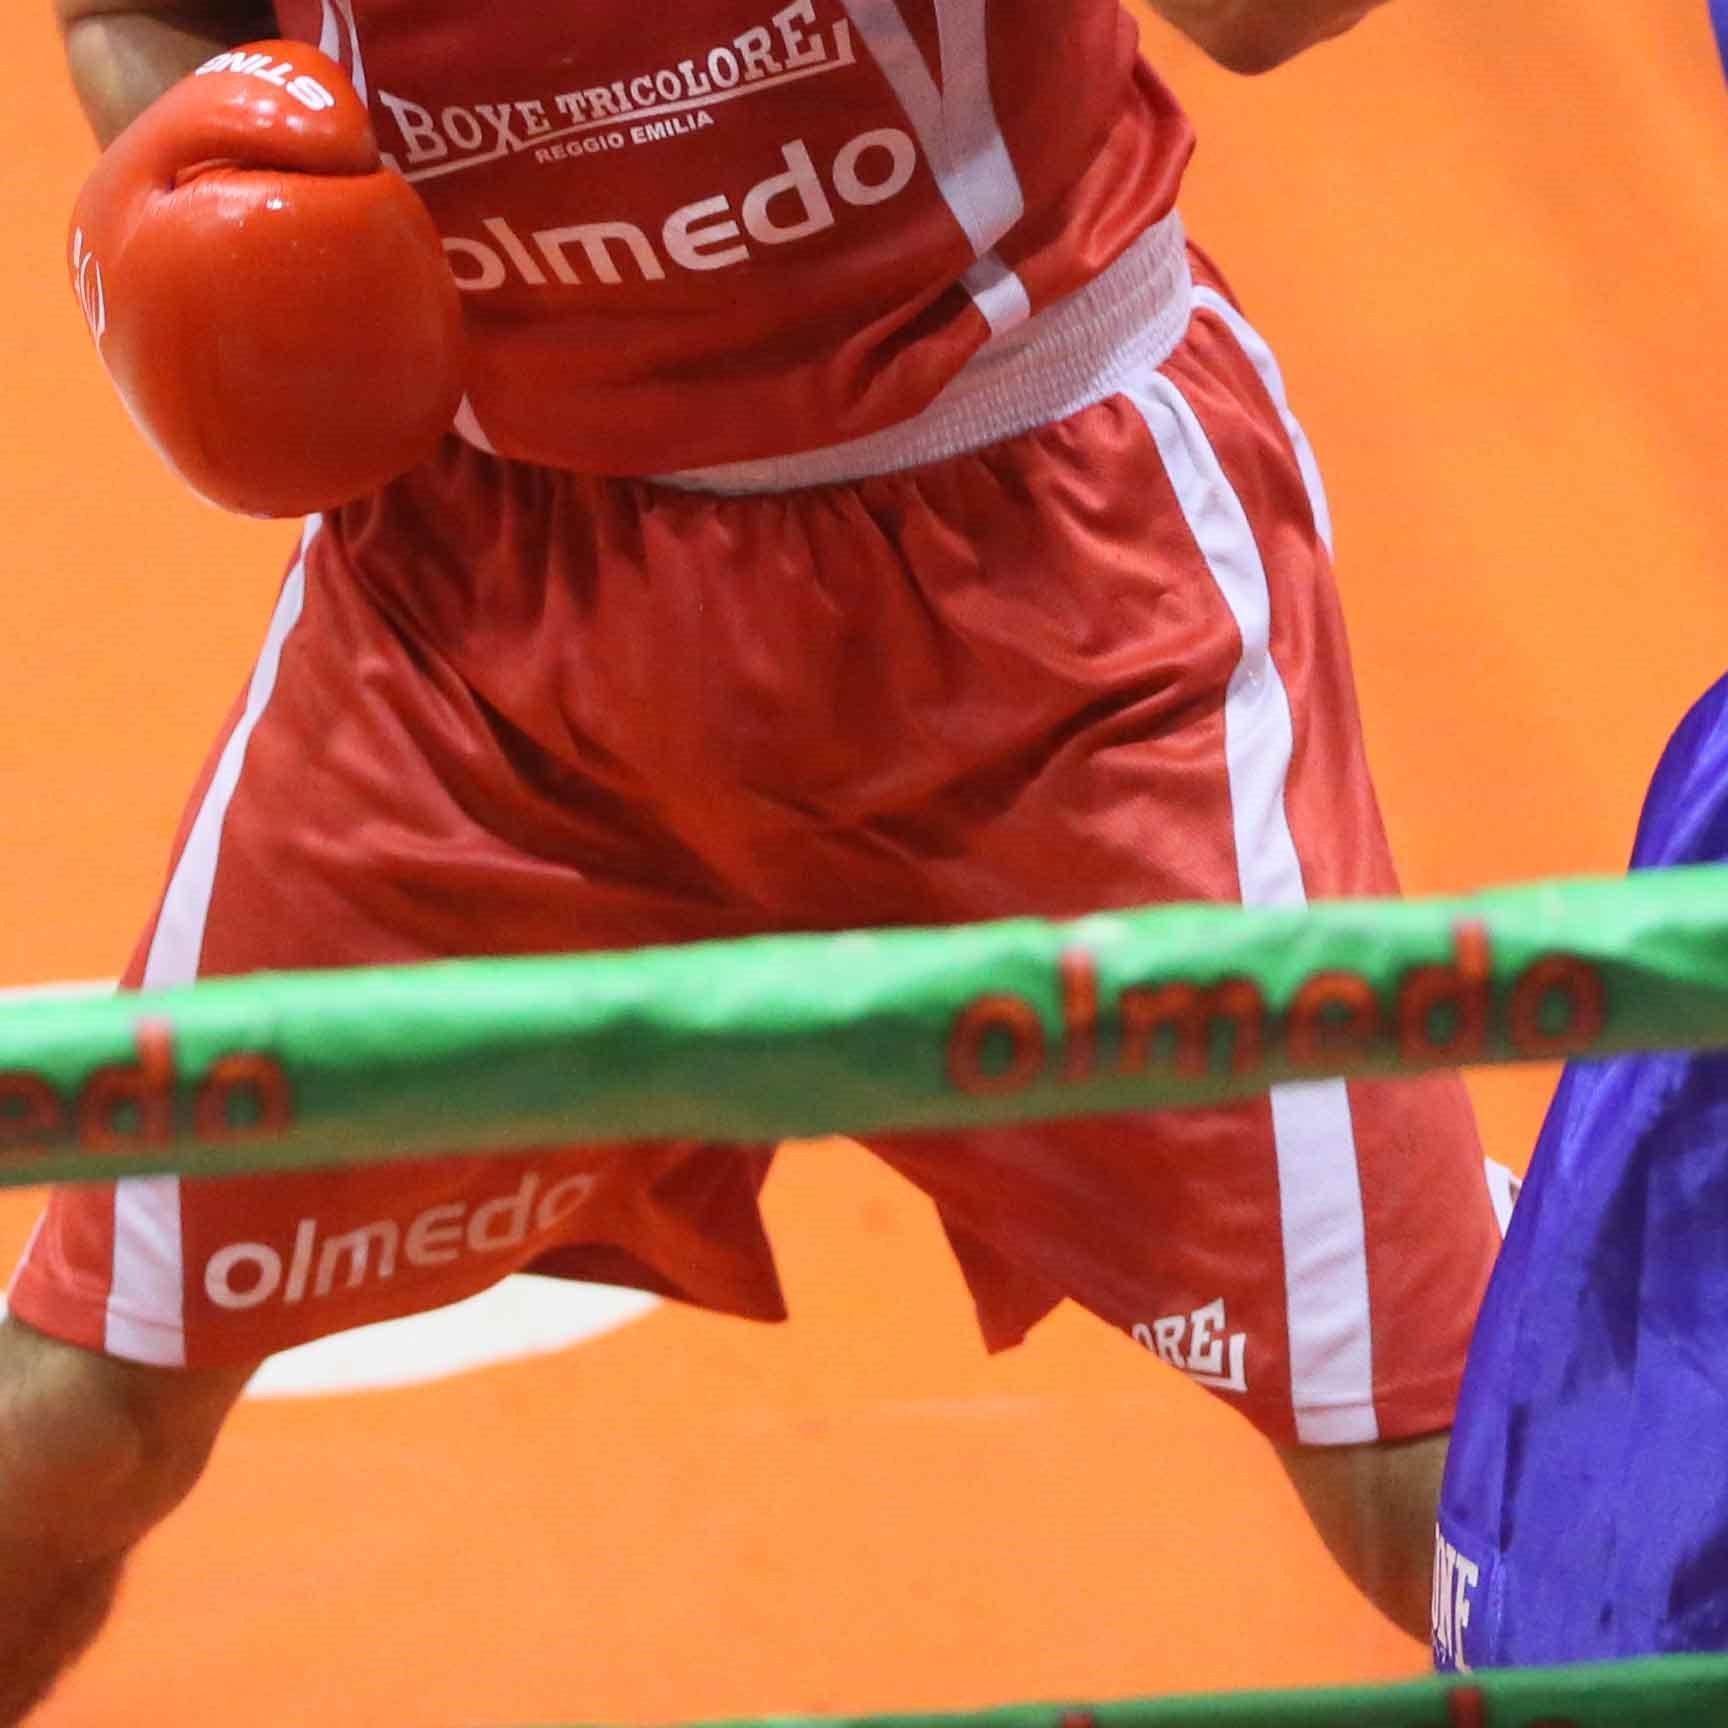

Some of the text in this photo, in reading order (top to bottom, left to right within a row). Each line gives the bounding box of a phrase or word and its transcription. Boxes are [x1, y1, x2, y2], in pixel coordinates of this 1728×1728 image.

[378, 88, 549, 166] BOXE
[534, 109, 715, 165] REGGIO EMILIA
[944, 918, 1610, 1100] olmedo
